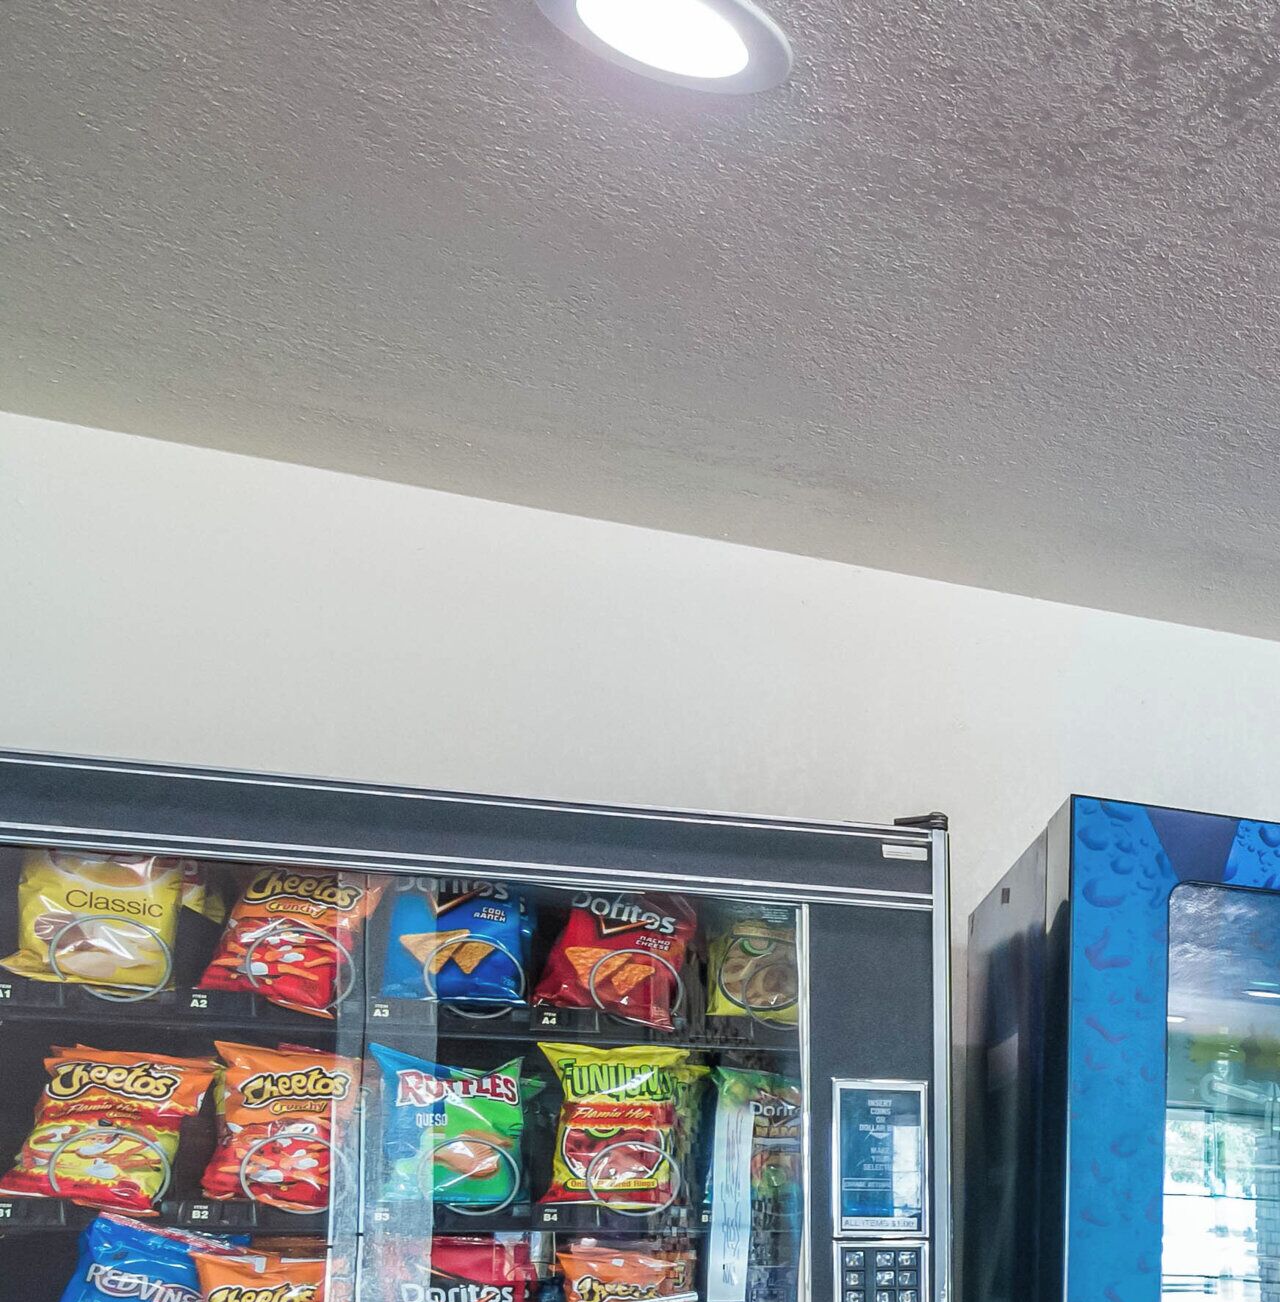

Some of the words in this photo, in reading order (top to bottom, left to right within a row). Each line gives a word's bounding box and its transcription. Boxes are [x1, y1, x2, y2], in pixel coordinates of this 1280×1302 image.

[245, 867, 361, 911] Cheetos
[66, 888, 163, 918] Classic
[266, 901, 325, 916] Crunchy
[474, 912, 506, 922] RANCH
[482, 907, 505, 916] COOL
[571, 892, 677, 934] Doritos
[635, 939, 670, 951] CHEESE
[639, 935, 671, 946] NACHO
[191, 999, 207, 1008] A2
[374, 1008, 389, 1017] A3
[46, 1061, 182, 1101] Cheetos
[239, 1069, 350, 1107] Cheetos
[270, 1100, 327, 1114] Crunchy
[625, 1108, 653, 1119] Hot
[416, 1112, 448, 1127] QUESO
[192, 1210, 209, 1219] B2
[374, 1212, 390, 1222] B3
[544, 1213, 558, 1222] B4
[904, 1273, 910, 1284] 7
[882, 1293, 889, 1302] 3
